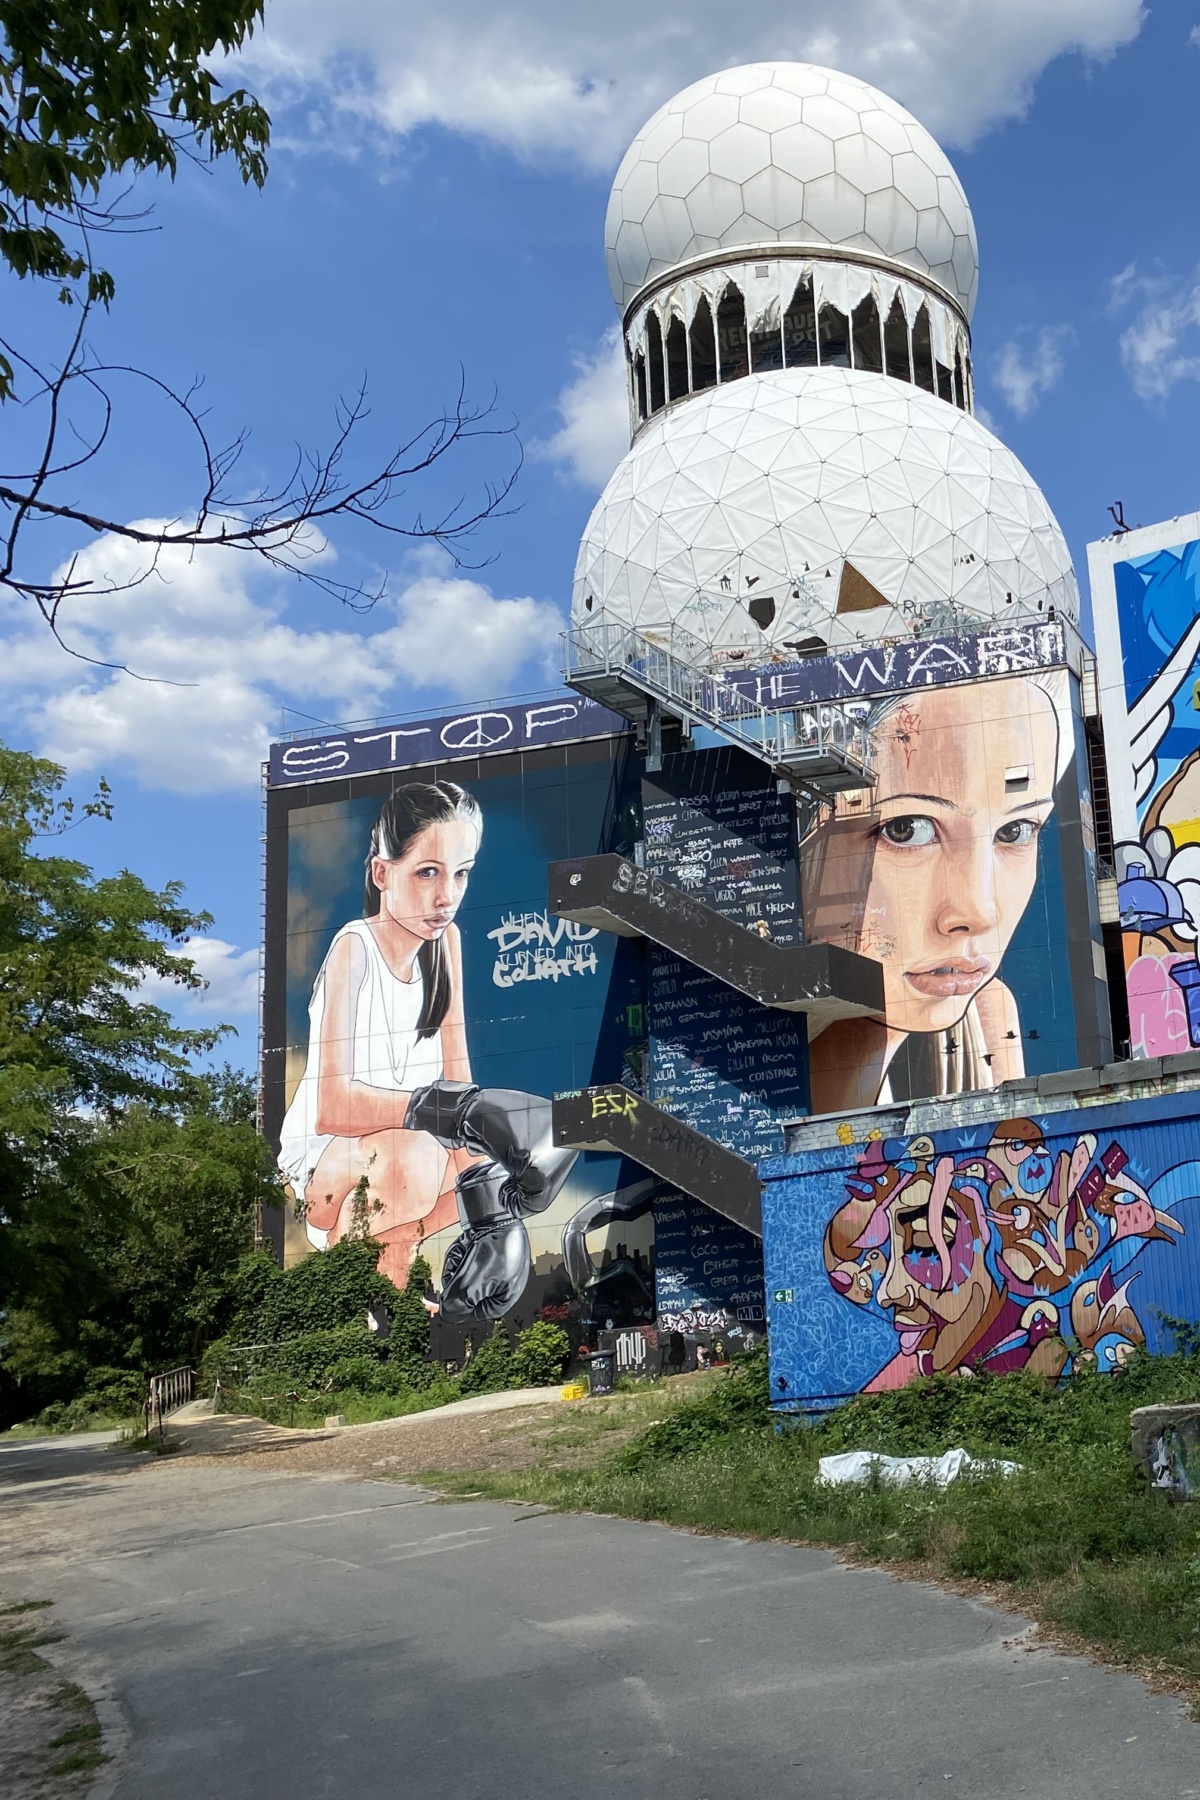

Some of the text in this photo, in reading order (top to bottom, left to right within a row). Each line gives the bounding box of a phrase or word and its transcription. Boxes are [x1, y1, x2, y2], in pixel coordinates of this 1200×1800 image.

[679, 794, 710, 807] ROSA
[645, 813, 679, 827] MICHELLE
[723, 837, 745, 850] KATE
[741, 882, 782, 896] ANNALENA
[765, 900, 796, 915] HELEN
[500, 908, 548, 926] WHEN
[487, 917, 601, 953] DAVID
[497, 947, 556, 966] TURNED
[492, 952, 599, 988] GOLIATH
[678, 1010, 722, 1024] GERTRUDE
[653, 1068, 677, 1083] JULIA
[676, 1081, 716, 1096] SIMONE
[748, 1108, 771, 1120] ERIN
[739, 1142, 773, 1157] SHIRIN
[691, 1244, 720, 1259] COCO
[703, 1258, 740, 1276] ESTHER
